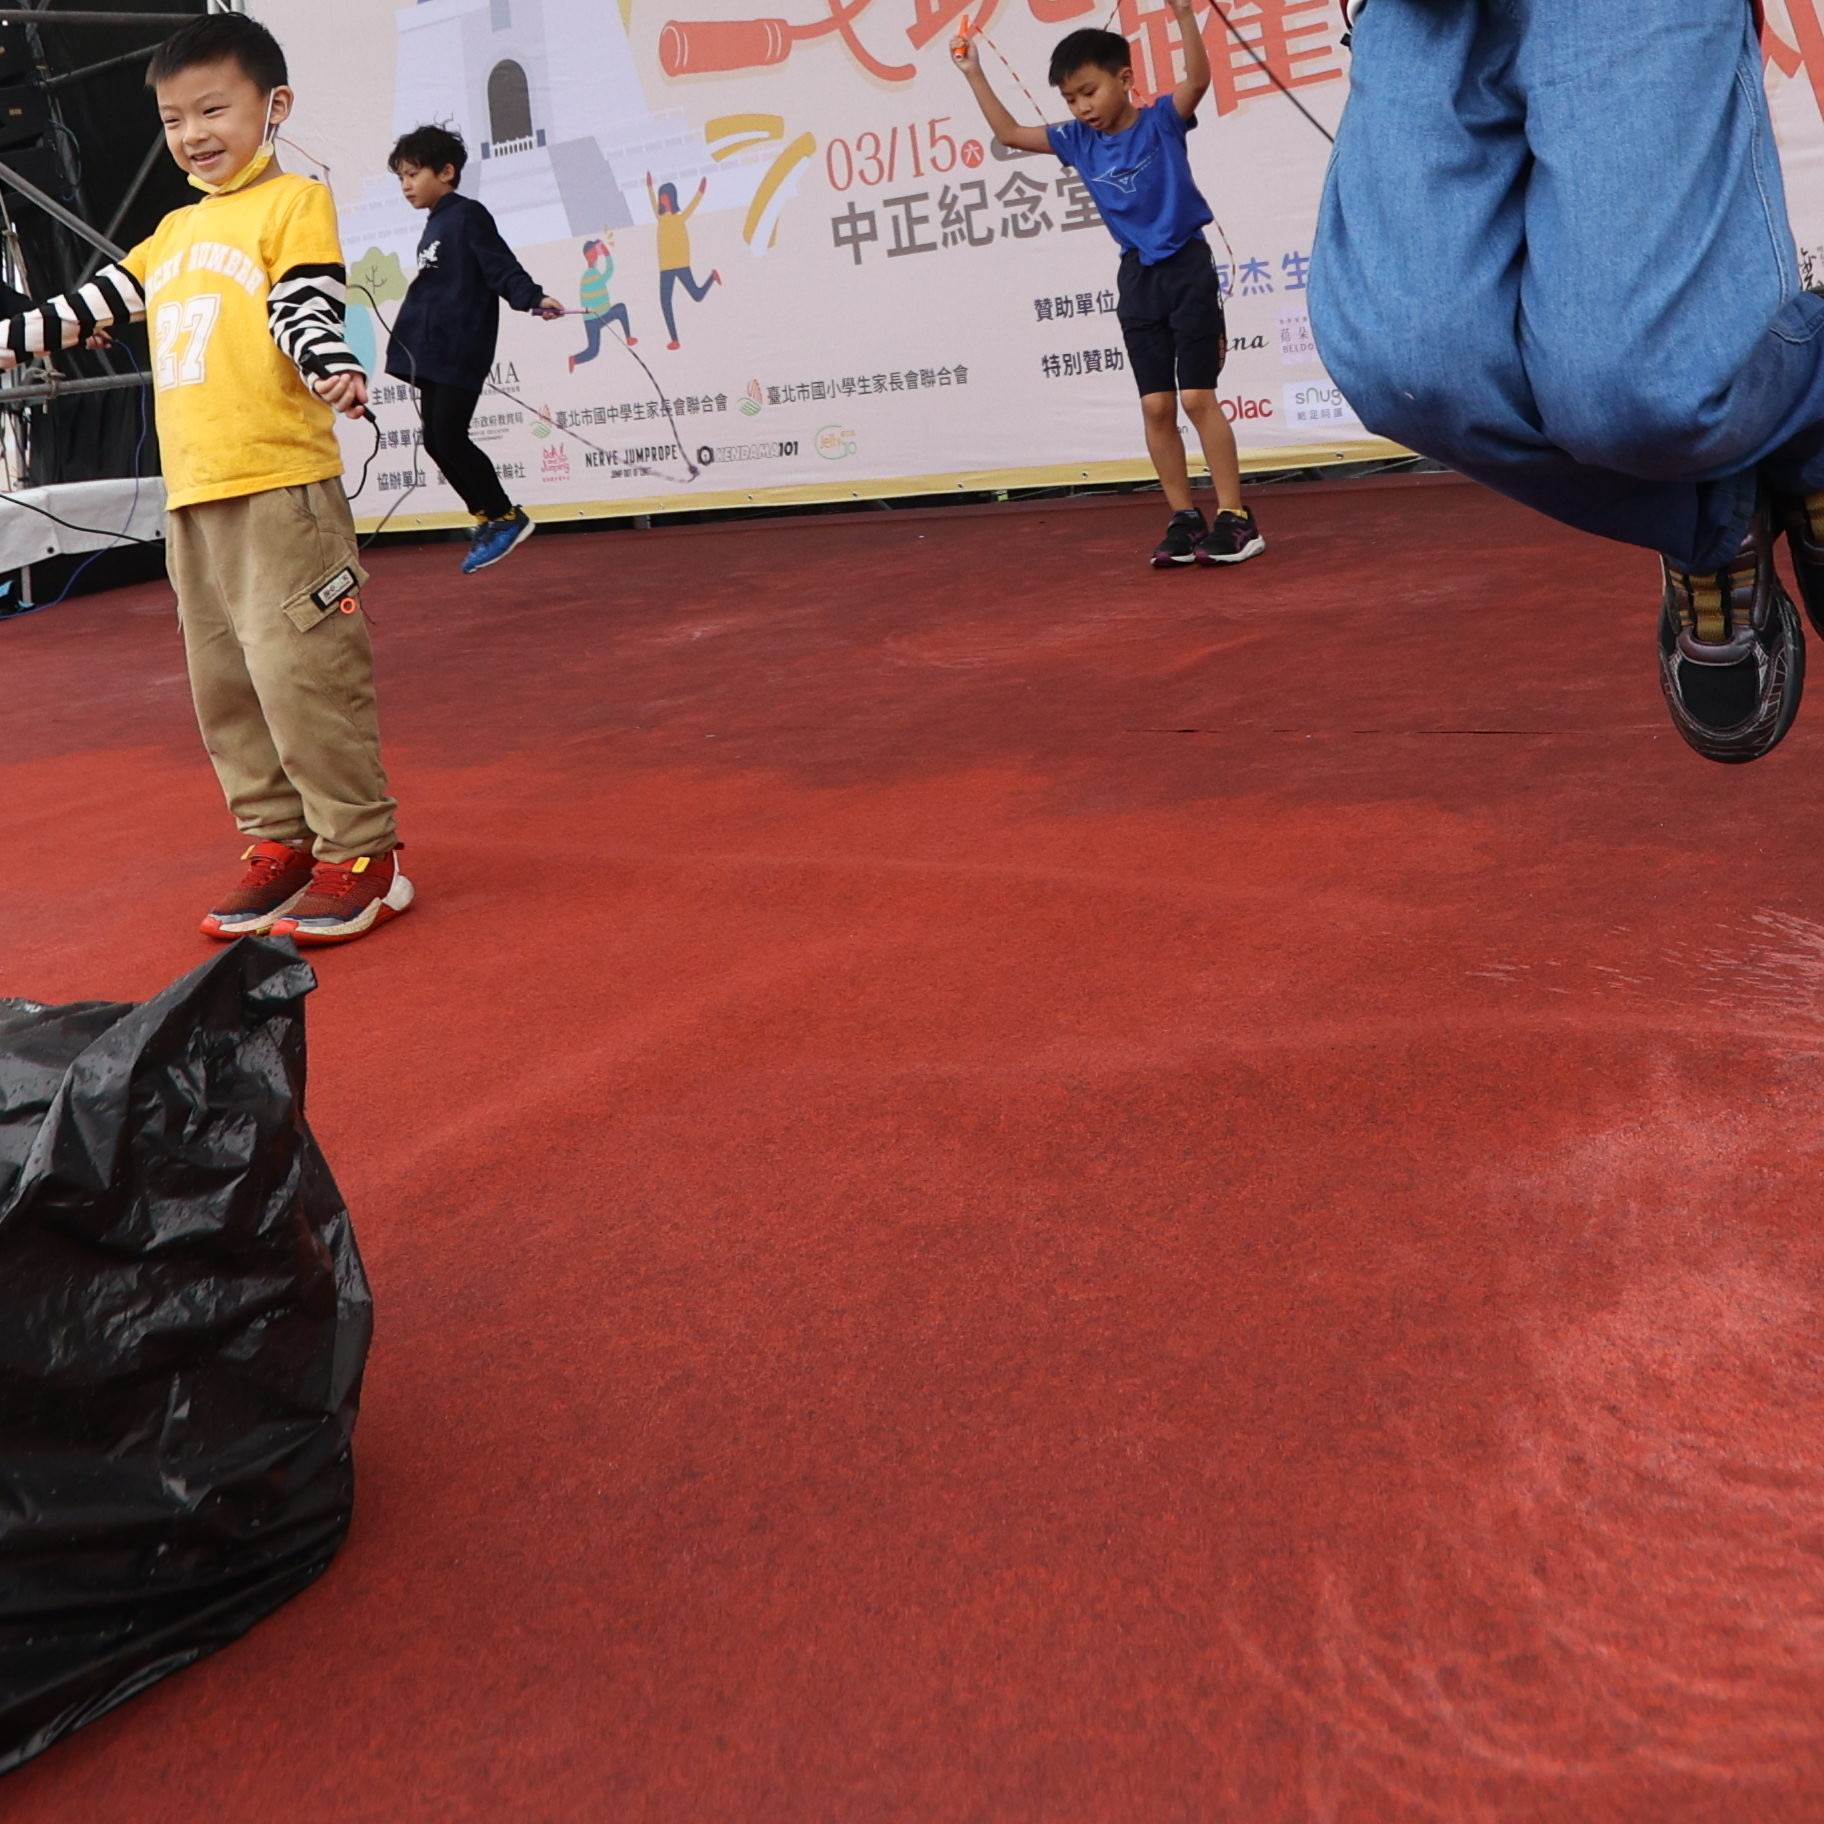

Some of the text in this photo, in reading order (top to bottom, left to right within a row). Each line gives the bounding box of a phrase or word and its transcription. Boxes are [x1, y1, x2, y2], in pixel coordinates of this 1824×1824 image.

[825, 116, 958, 193] 03/15
[155, 292, 222, 393] 27
[585, 448, 619, 468] NERVE
[623, 444, 678, 465] JUMPROPE
